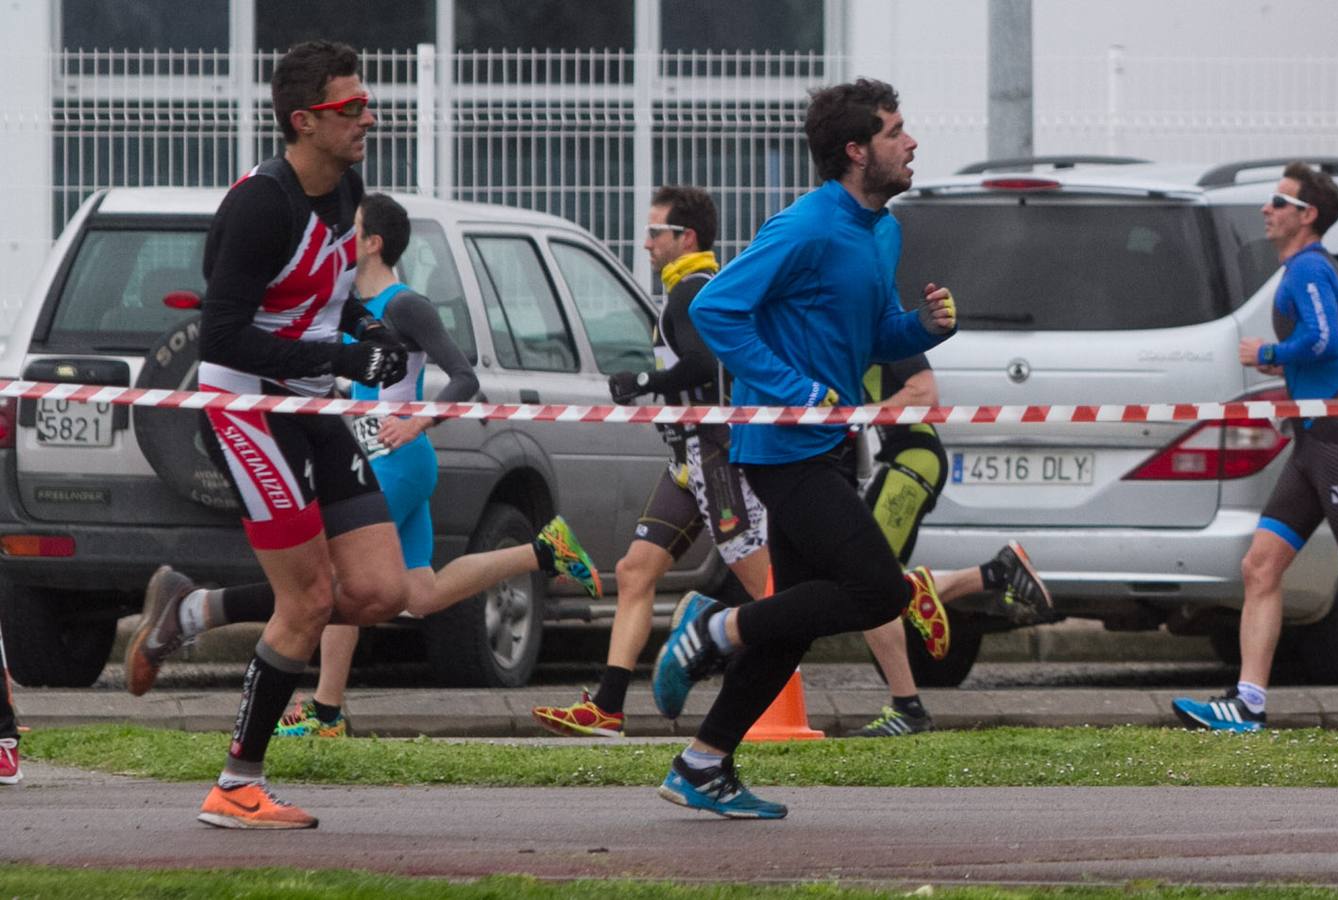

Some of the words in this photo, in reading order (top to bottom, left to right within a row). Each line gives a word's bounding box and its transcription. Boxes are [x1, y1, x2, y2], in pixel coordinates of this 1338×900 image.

[46, 417, 99, 441] 5821
[224, 426, 293, 509] SPECIALIZED
[970, 456, 1030, 480] 4516
[1042, 456, 1088, 480] DLY
